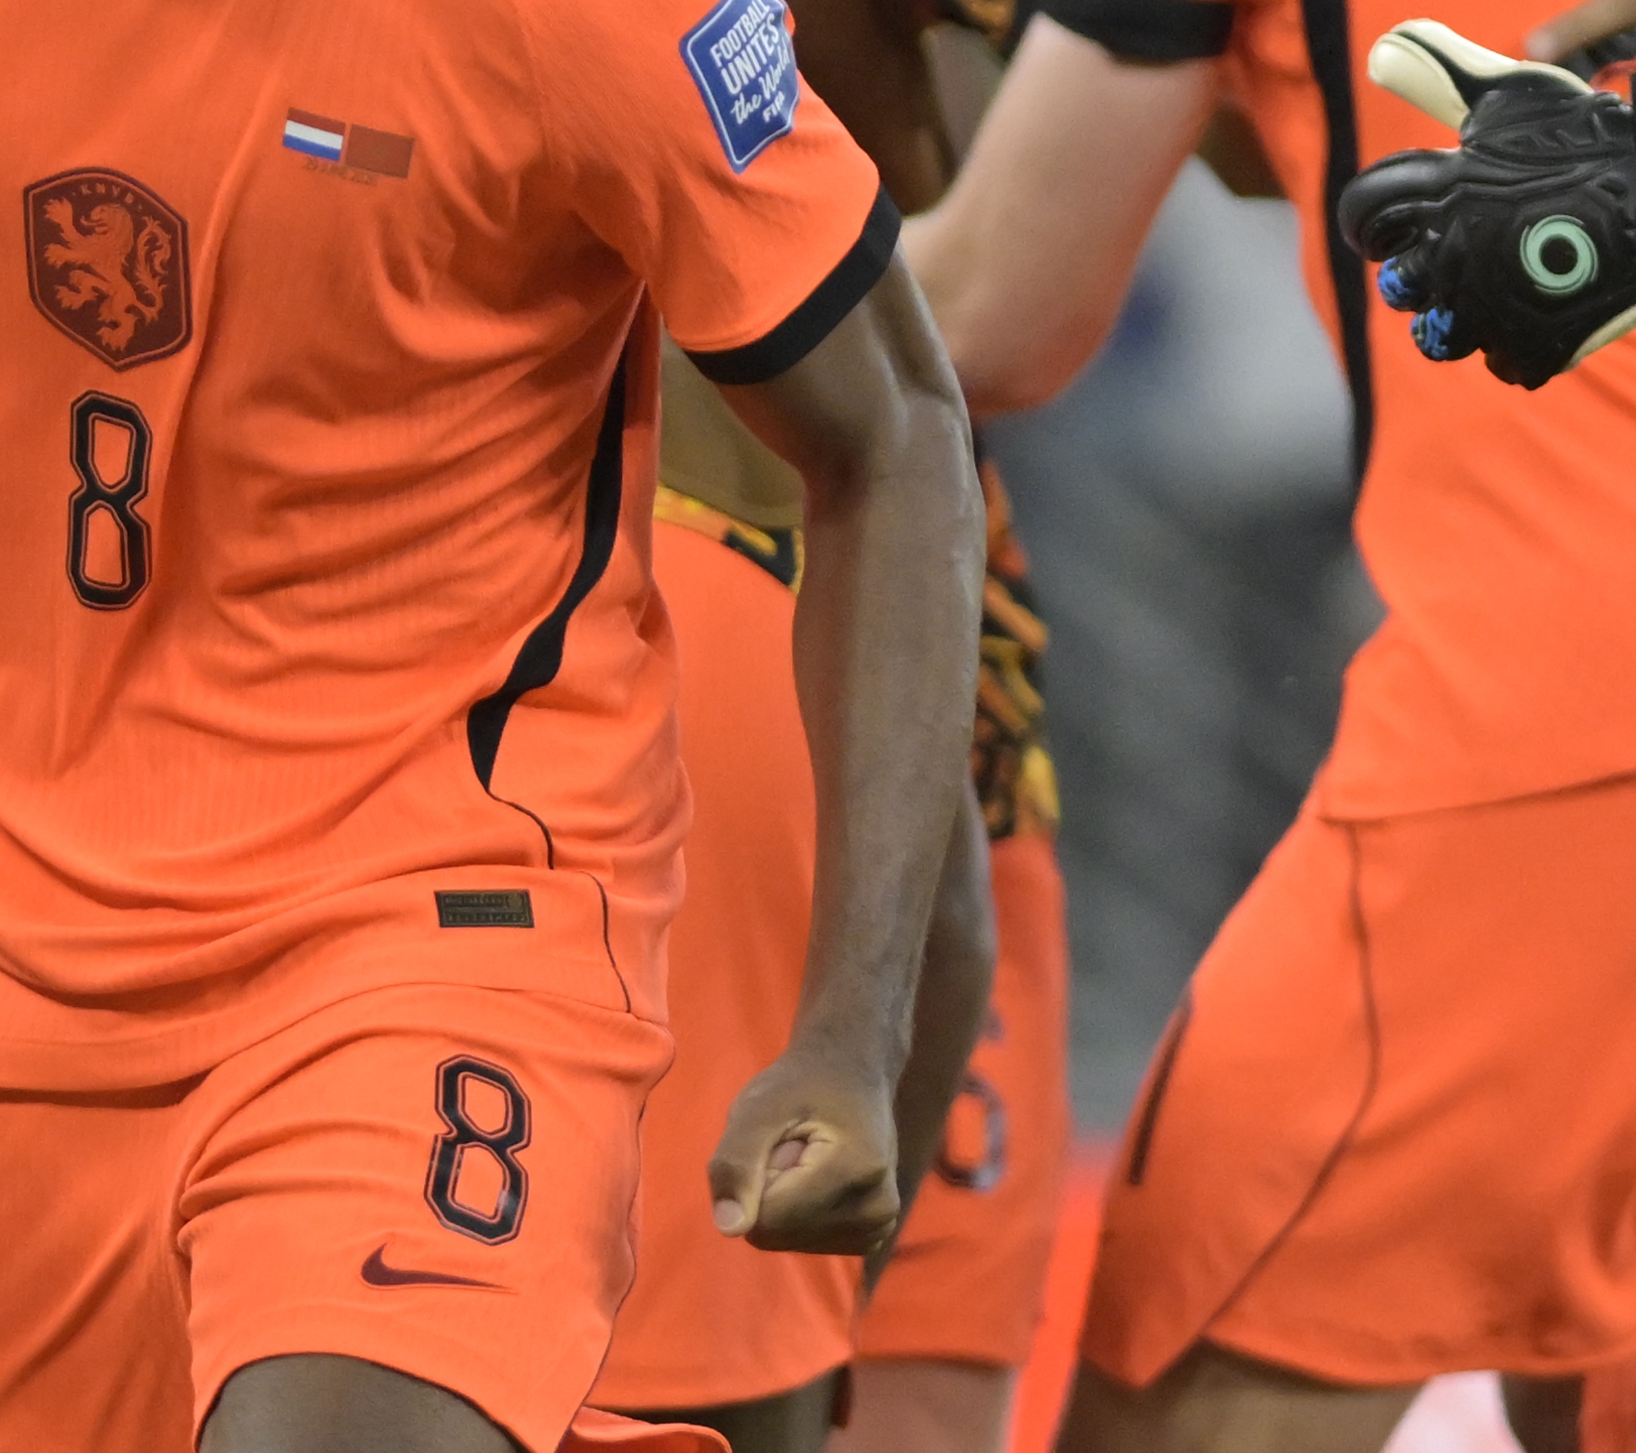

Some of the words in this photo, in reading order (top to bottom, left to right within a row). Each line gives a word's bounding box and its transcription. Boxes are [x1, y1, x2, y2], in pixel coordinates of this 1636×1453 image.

[721, 12, 780, 95] UNITES
[730, 92, 762, 125] the
[759, 36, 791, 94] World
[66, 389, 153, 612] 8
[423, 1053, 532, 1246] 8
